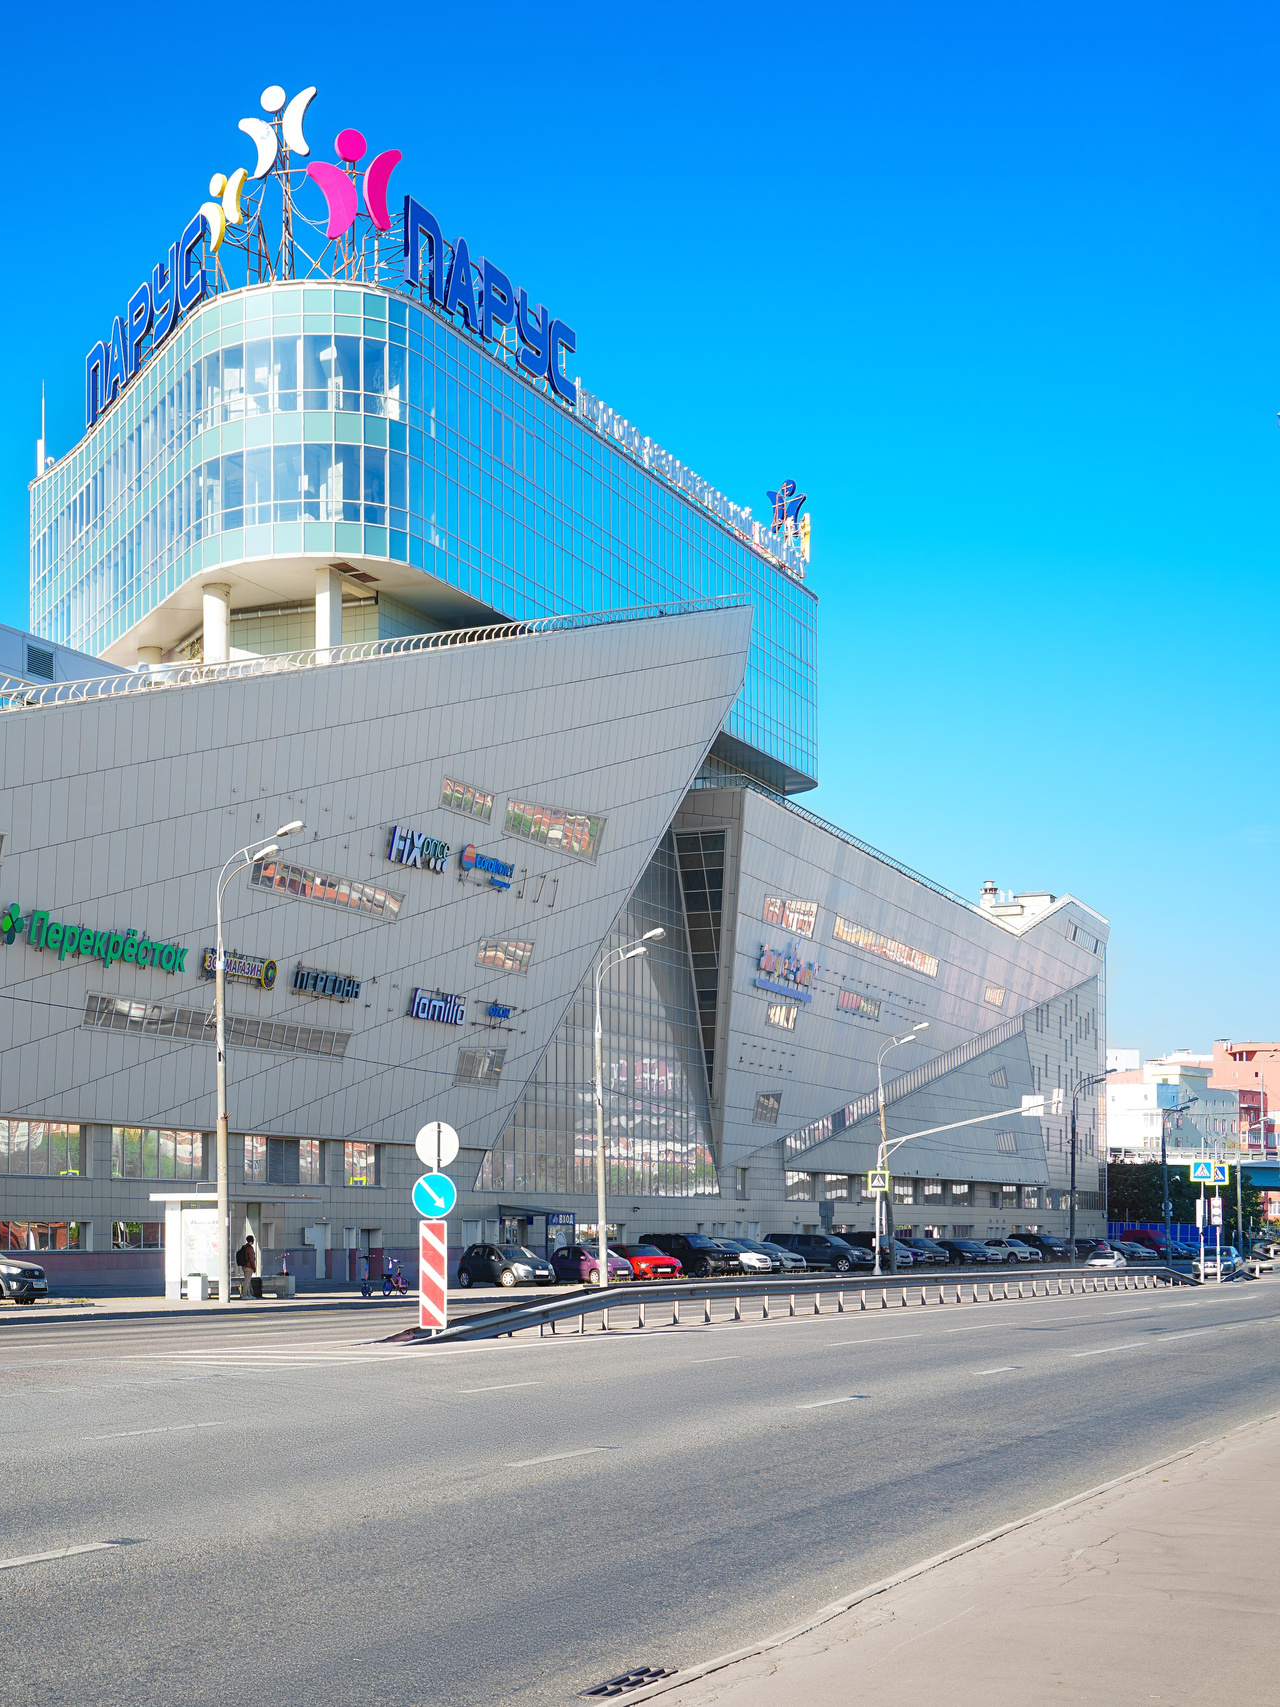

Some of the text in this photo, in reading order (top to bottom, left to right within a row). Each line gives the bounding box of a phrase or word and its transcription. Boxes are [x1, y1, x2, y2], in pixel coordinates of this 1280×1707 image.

[85, 213, 207, 429] ПАРУС
[404, 195, 577, 406] ПАРУС
[27, 909, 189, 973] Перекрёсток
[205, 953, 264, 979] ЗОМАГАЗИН
[294, 969, 362, 999] ПЕРСОНА
[558, 1214, 574, 1225] ВХОД
